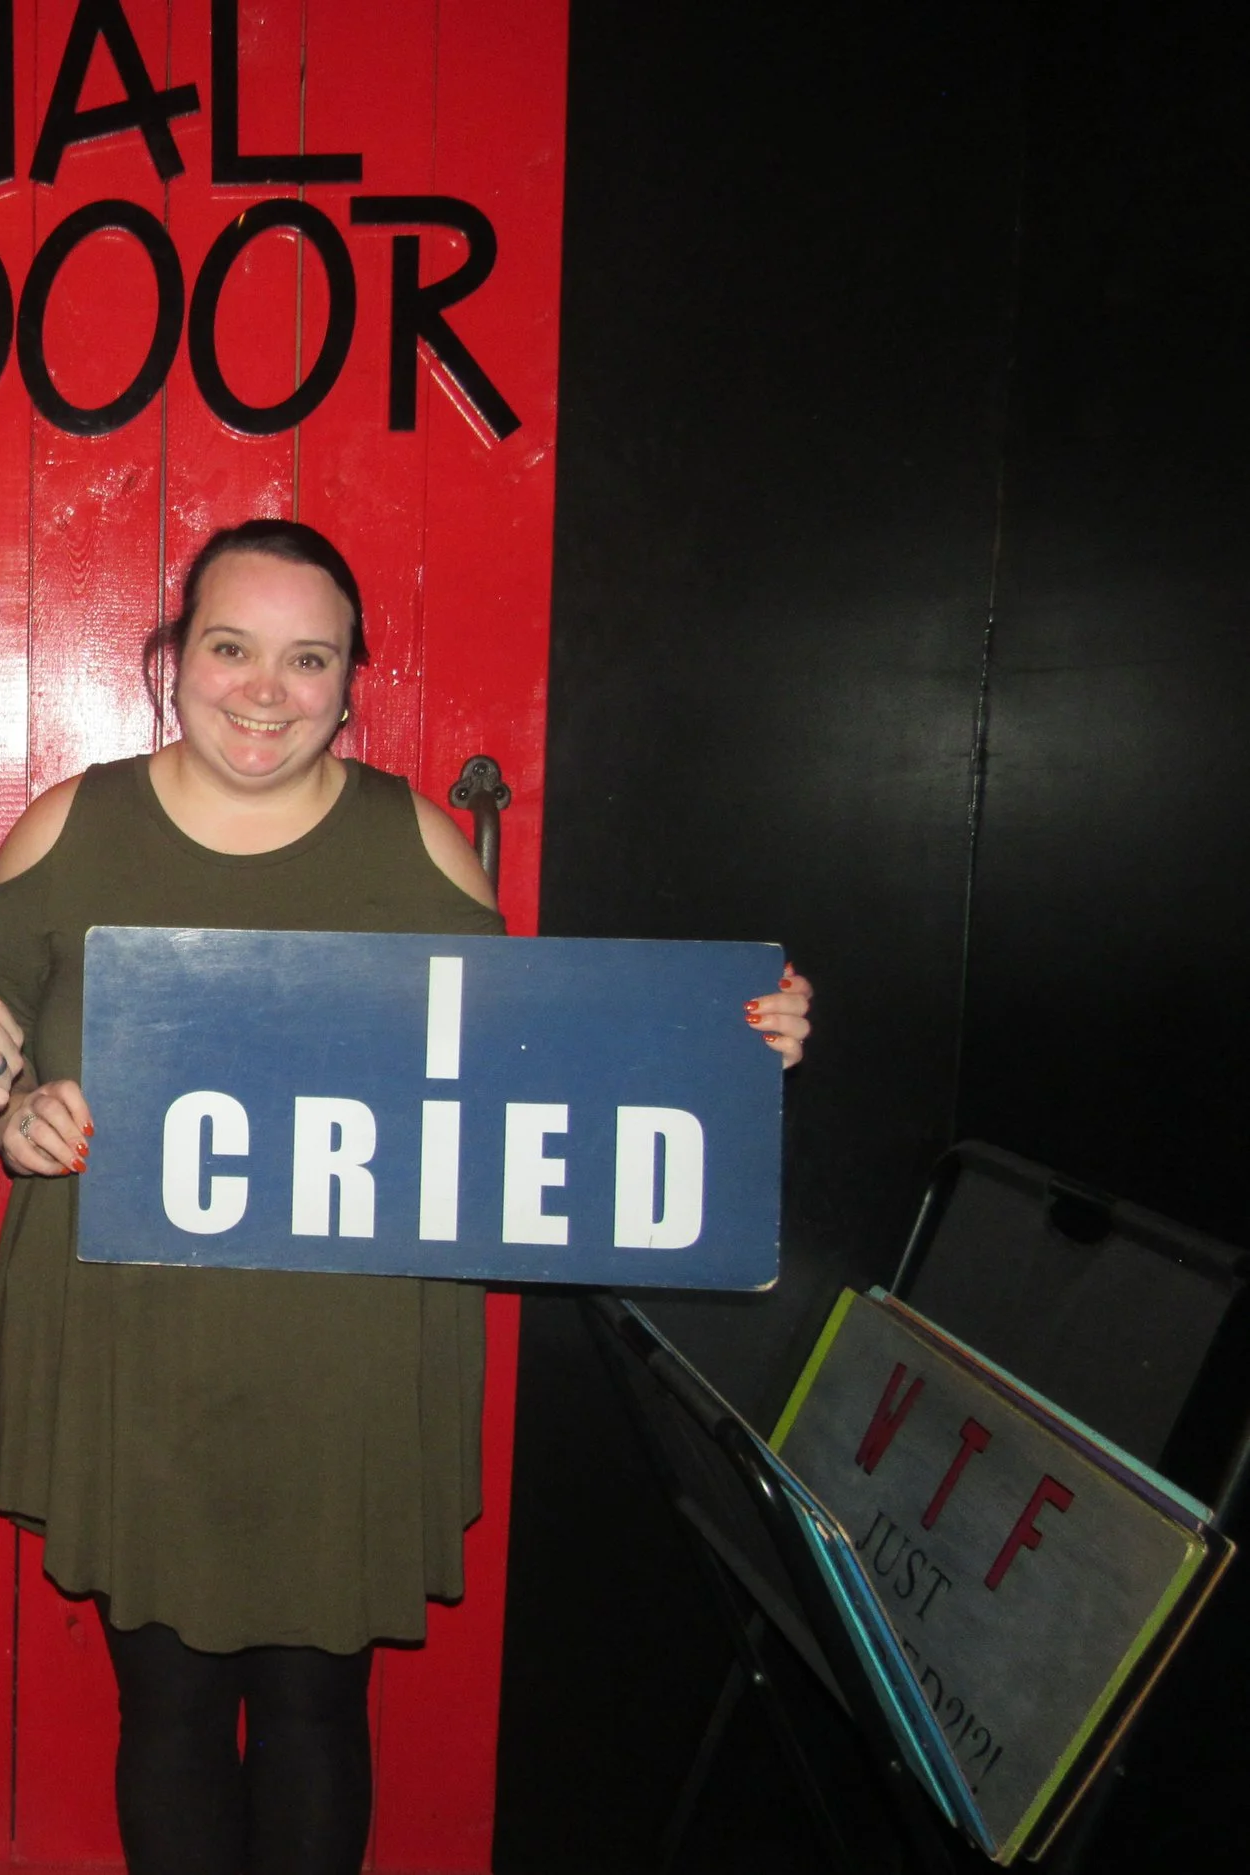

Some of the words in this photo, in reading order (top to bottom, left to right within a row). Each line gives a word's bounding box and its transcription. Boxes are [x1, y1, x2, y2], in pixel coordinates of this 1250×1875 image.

[426, 956, 464, 1080] I
[161, 1090, 705, 1250] CRIED
[855, 1362, 1075, 1592] WTF
[855, 1511, 953, 1620] JUST
